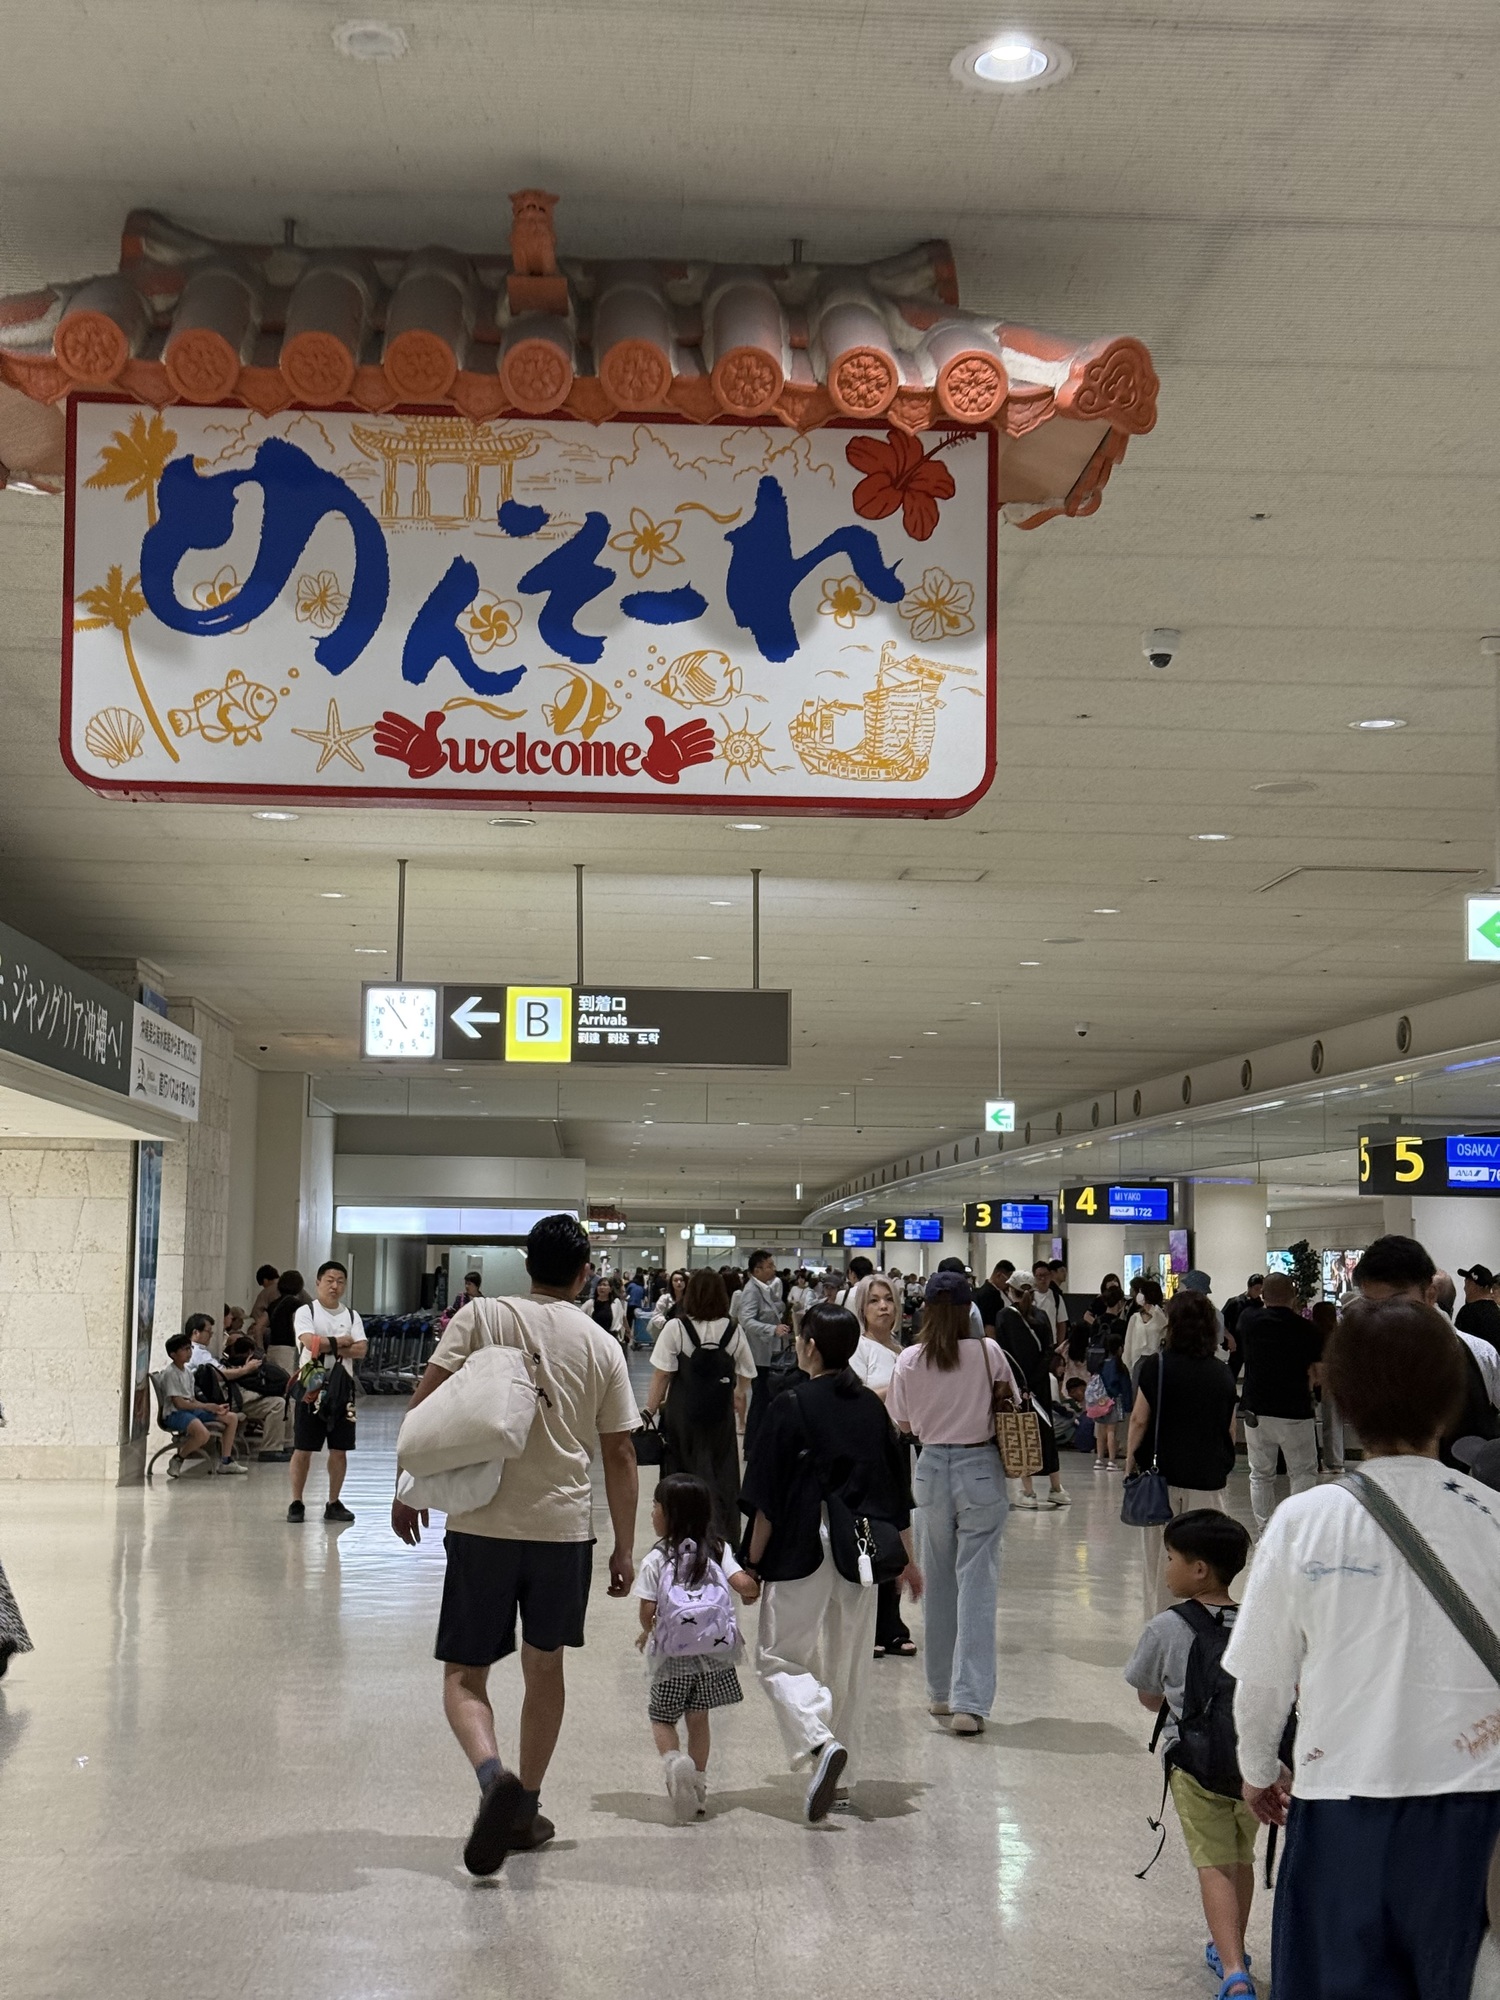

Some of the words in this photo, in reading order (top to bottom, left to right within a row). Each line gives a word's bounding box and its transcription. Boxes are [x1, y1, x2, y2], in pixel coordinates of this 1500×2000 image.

[140, 436, 907, 694] めんそーれ
[442, 732, 642, 776] welcome
[578, 995, 626, 1012] 到着口
[526, 1001, 549, 1037] B
[578, 1013, 628, 1026] Arrivals
[1395, 1136, 1425, 1182] 5
[1075, 1187, 1098, 1216] 4
[1134, 1207, 1152, 1217] 1722
[975, 1203, 992, 1227] 3
[828, 1228, 838, 1244] 1
[883, 1218, 897, 1238] 2
